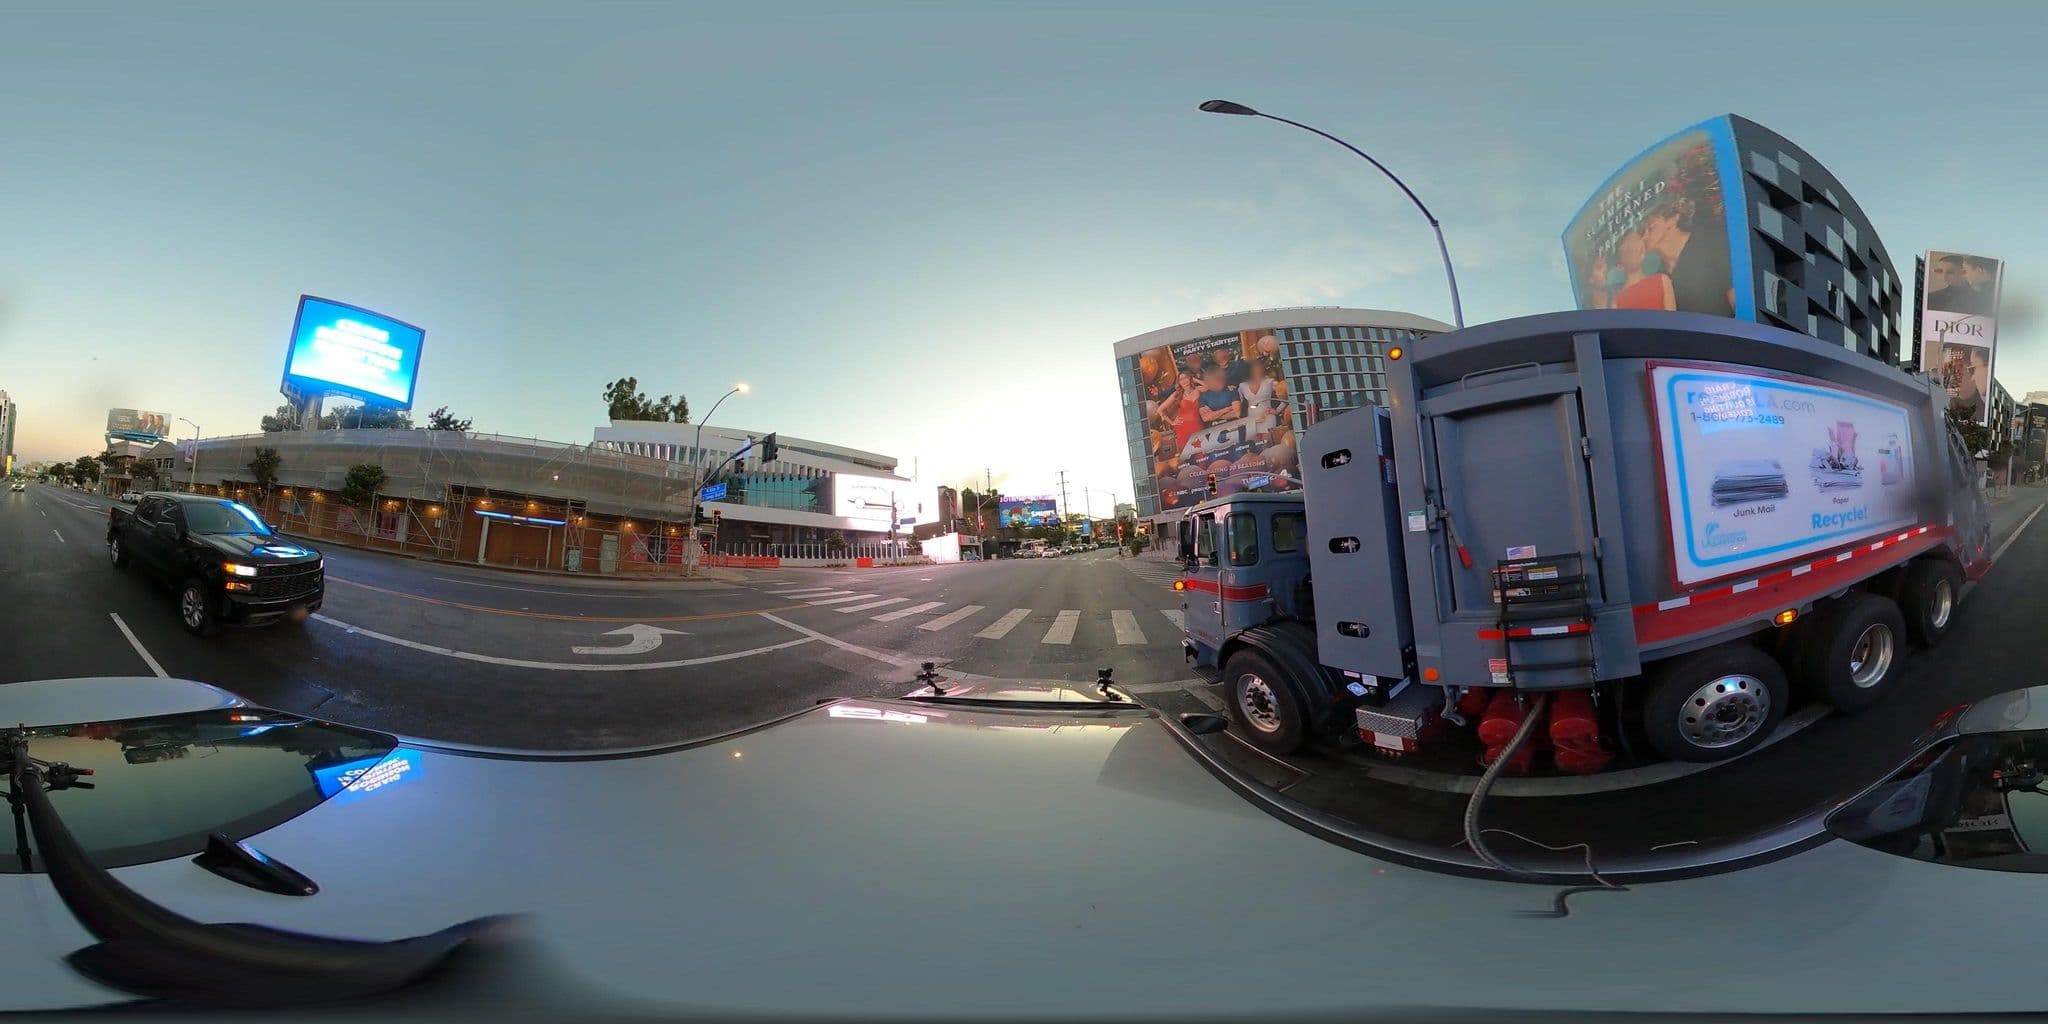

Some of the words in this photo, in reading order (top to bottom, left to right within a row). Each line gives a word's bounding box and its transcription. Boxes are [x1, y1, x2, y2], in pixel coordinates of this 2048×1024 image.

[1608, 181, 1665, 234] TURNED
[1598, 208, 1648, 257] PRETTY
[1934, 318, 1984, 338] DIOR
[1183, 345, 1205, 355] PARTY
[1733, 508, 1755, 518] Junk
[1757, 504, 1776, 514] Mail
[1811, 507, 1868, 530] Recycle!
